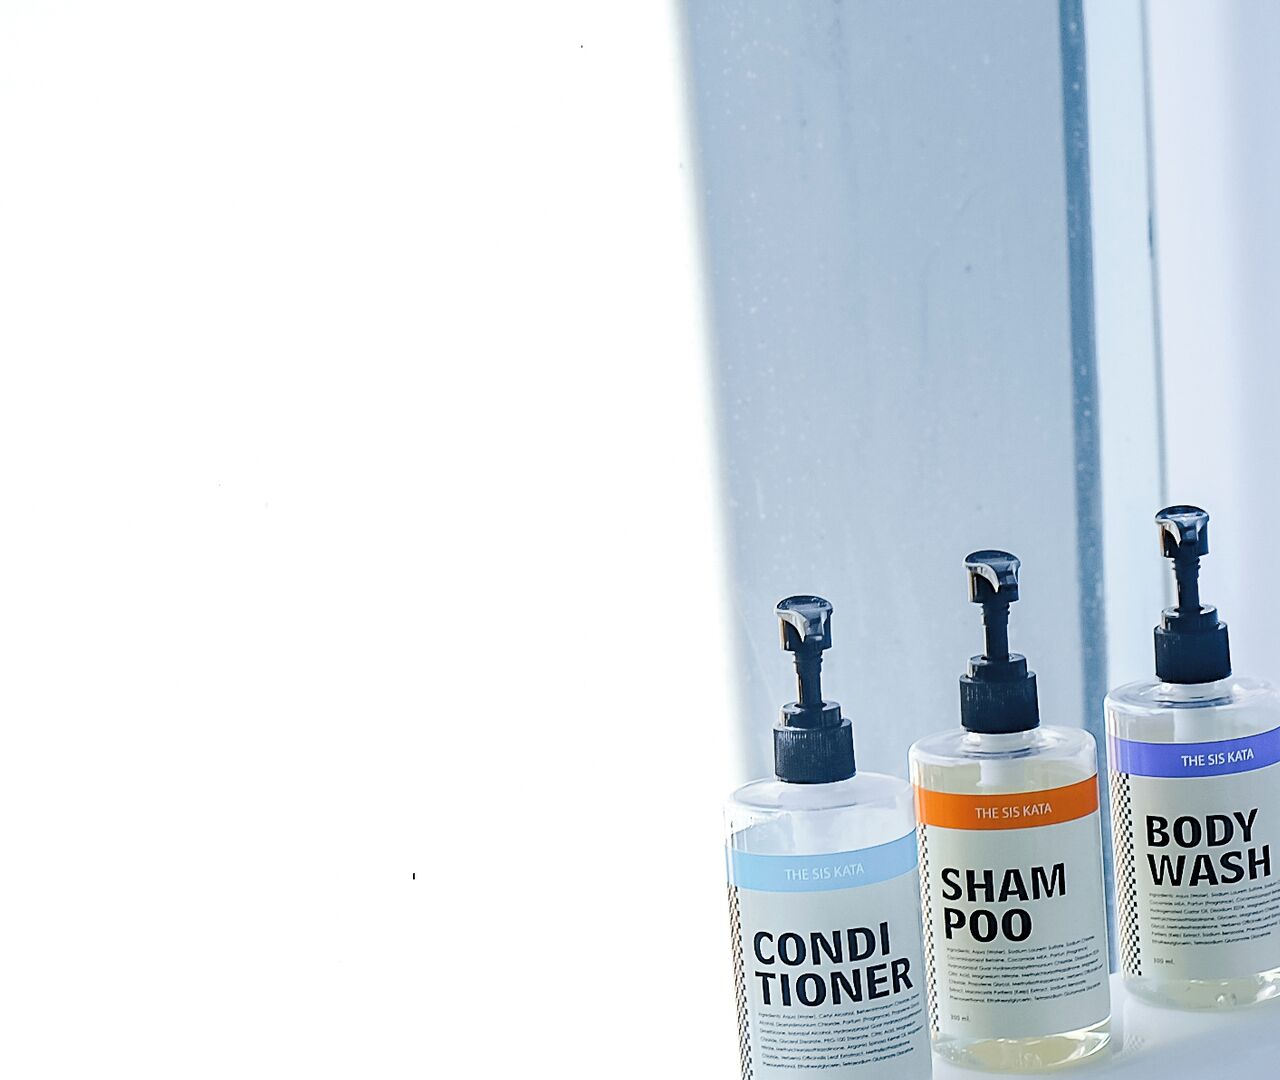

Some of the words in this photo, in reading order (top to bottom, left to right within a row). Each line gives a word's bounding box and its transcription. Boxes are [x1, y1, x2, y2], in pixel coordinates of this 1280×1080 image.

[1181, 755, 1205, 767] THE
[1208, 754, 1224, 766] SIS
[1228, 748, 1254, 763] KATA
[975, 807, 999, 819] THE
[1002, 806, 1020, 818] SIS
[1022, 802, 1052, 816] KATA
[1146, 808, 1258, 848] BODY
[784, 868, 809, 881] THE
[812, 866, 831, 879] SIS
[834, 863, 864, 878] KATA
[941, 862, 1066, 902] SHAM
[1147, 844, 1271, 886] WASH
[753, 921, 890, 966] CONDI
[944, 907, 1032, 943] POO
[755, 957, 913, 1006] TIONER
